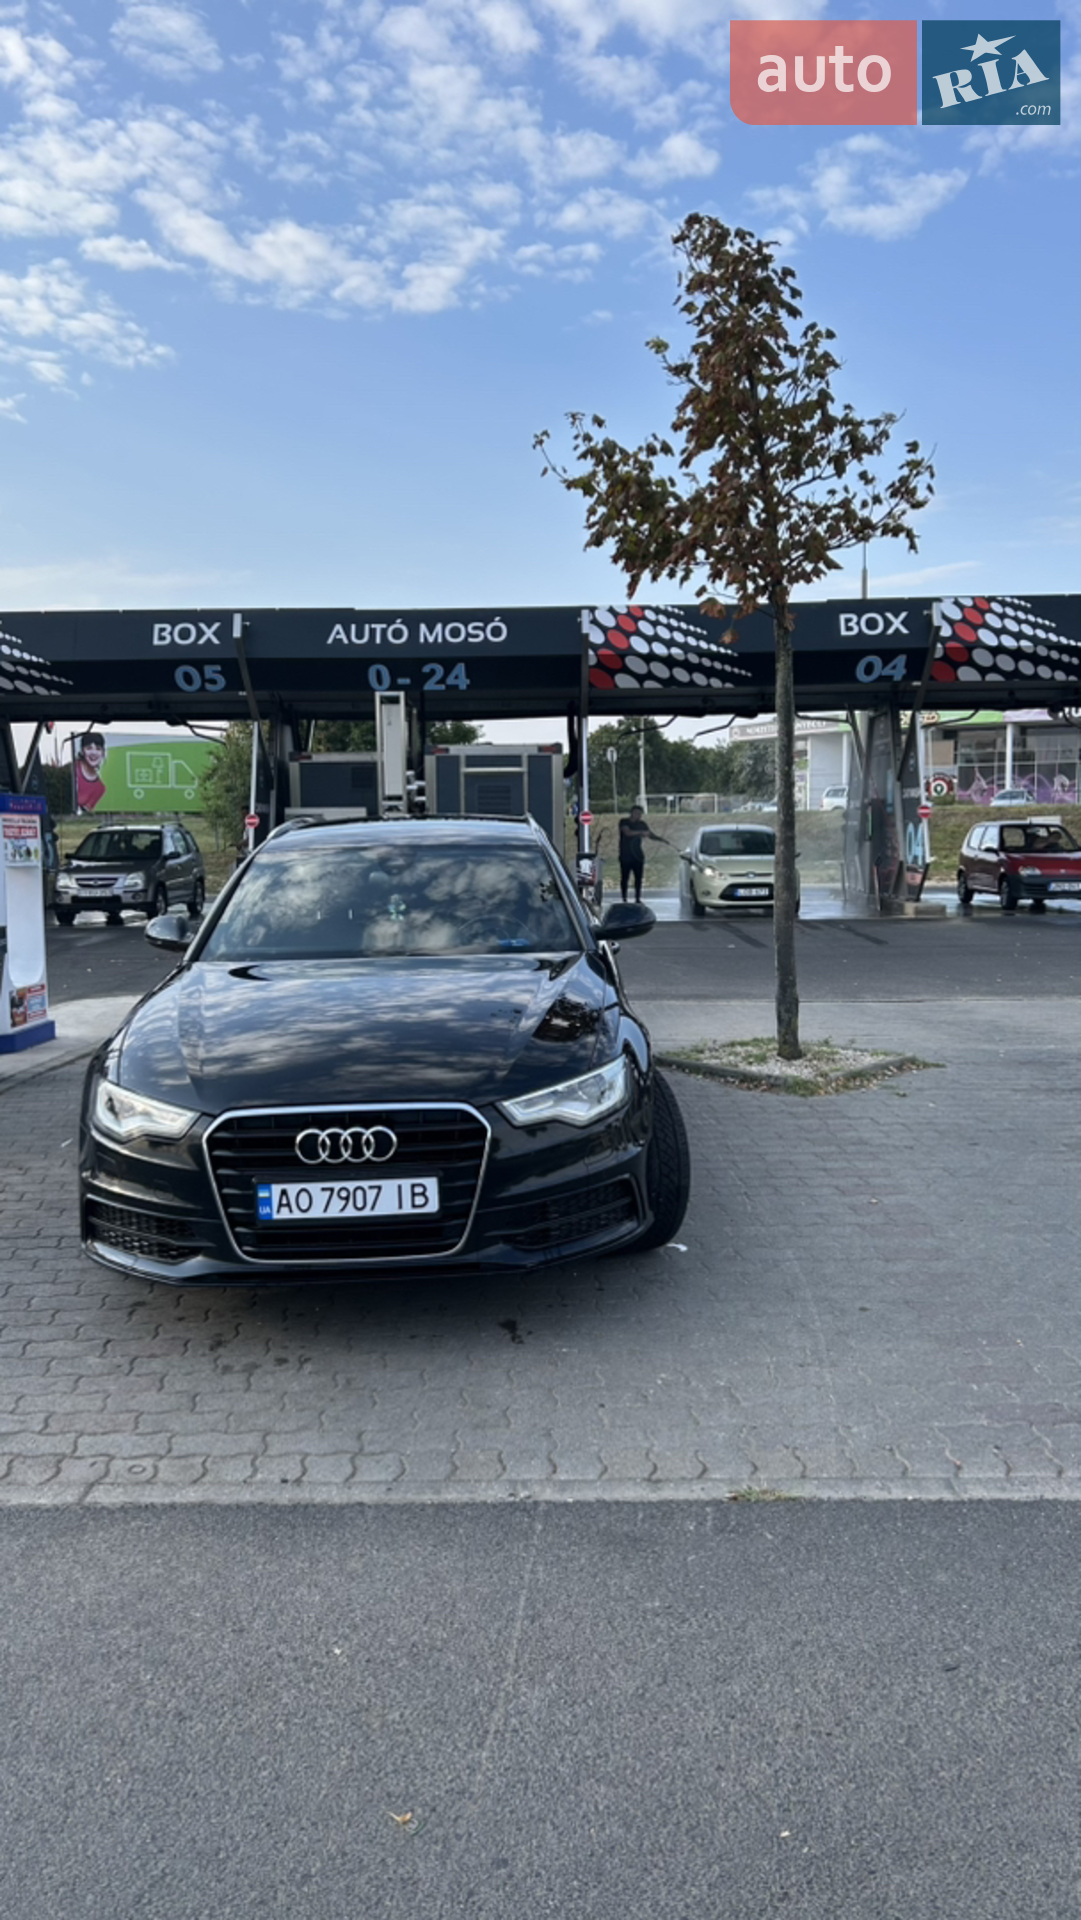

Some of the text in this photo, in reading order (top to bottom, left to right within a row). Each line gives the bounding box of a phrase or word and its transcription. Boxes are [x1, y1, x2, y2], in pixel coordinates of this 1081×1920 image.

[153, 622, 221, 645] BOX
[327, 617, 508, 645] AUTÓ MOSÓ
[839, 611, 910, 636] BOX
[174, 664, 226, 692] 05
[368, 664, 392, 691] 0
[422, 662, 471, 691] 24
[856, 654, 907, 683] 04
[259, 1206, 272, 1215] UA
[276, 1183, 429, 1214] AO 7907 IB
